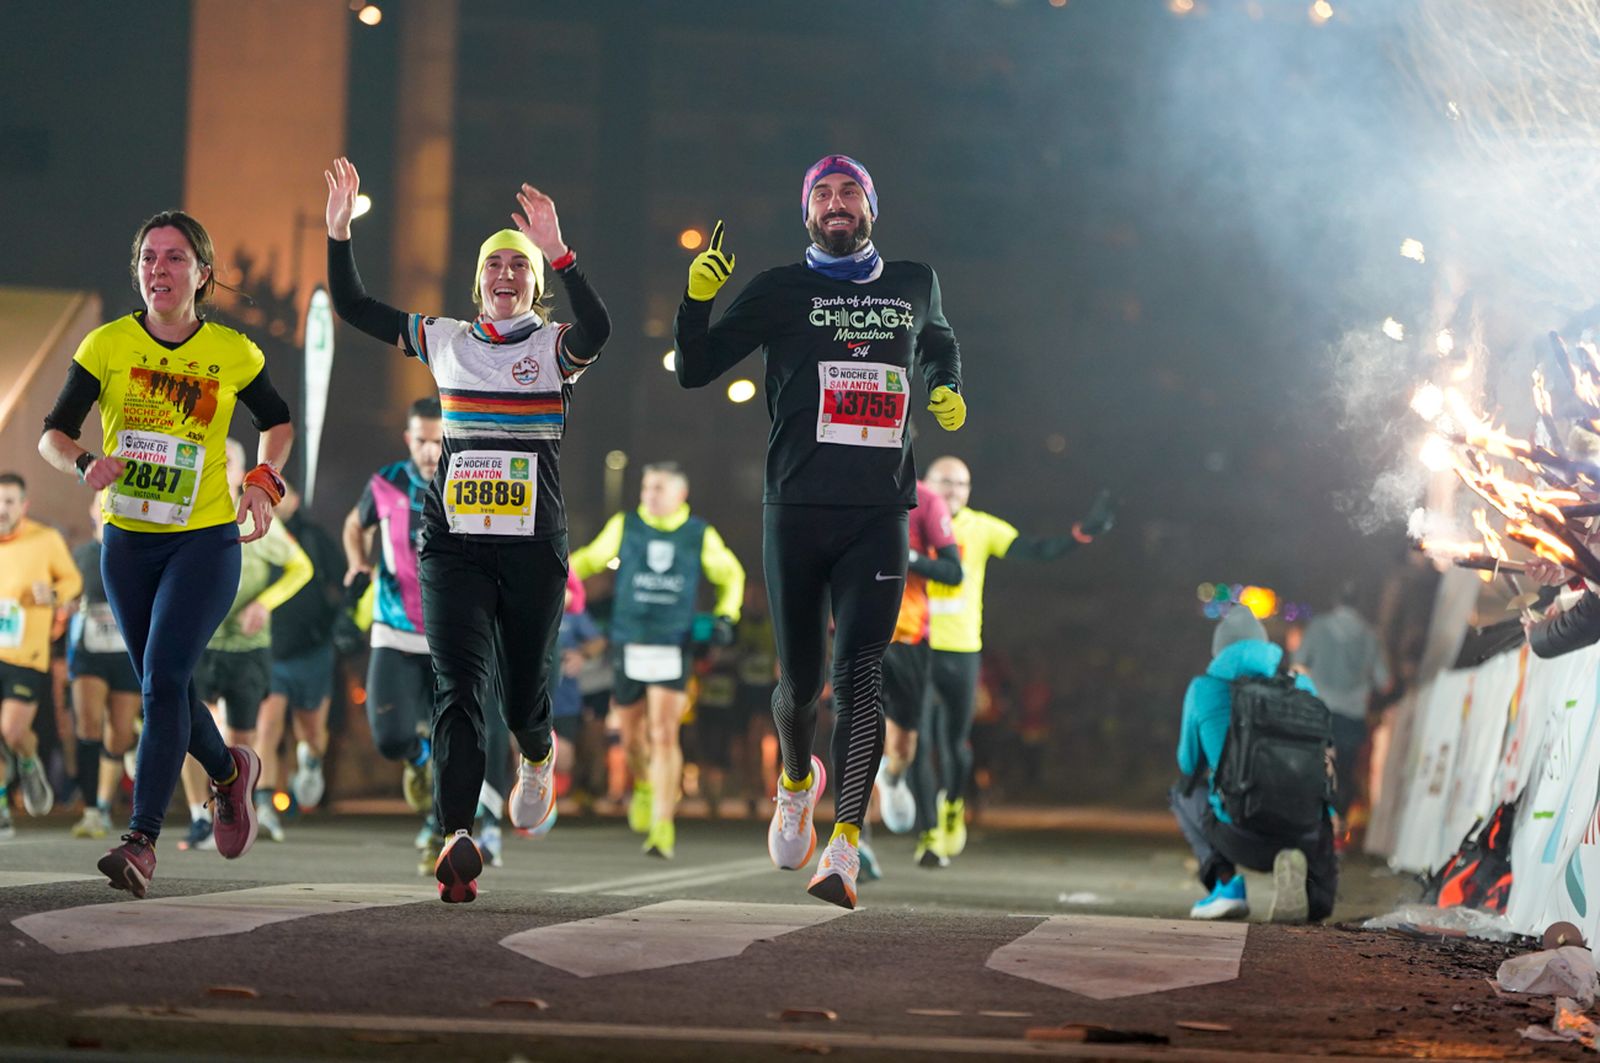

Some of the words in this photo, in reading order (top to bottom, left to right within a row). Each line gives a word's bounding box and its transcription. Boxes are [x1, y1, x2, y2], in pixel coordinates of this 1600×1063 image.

[811, 296, 845, 308] Bank
[846, 296, 860, 307] of
[861, 296, 912, 310] America
[833, 328, 895, 341] Marathon
[852, 345, 870, 357] 24
[840, 371, 867, 380] NOCHE
[868, 372, 879, 380] DE
[830, 380, 848, 389] SAN
[850, 380, 879, 390] ANTÓN
[833, 391, 897, 418] 13755
[124, 408, 156, 416] NOCHE
[156, 443, 168, 452] DE
[464, 460, 490, 468] NOCHE
[124, 460, 182, 494] 2847
[454, 470, 470, 479] SAN
[472, 469, 502, 479] ANTÓN
[453, 480, 526, 506] 13889
